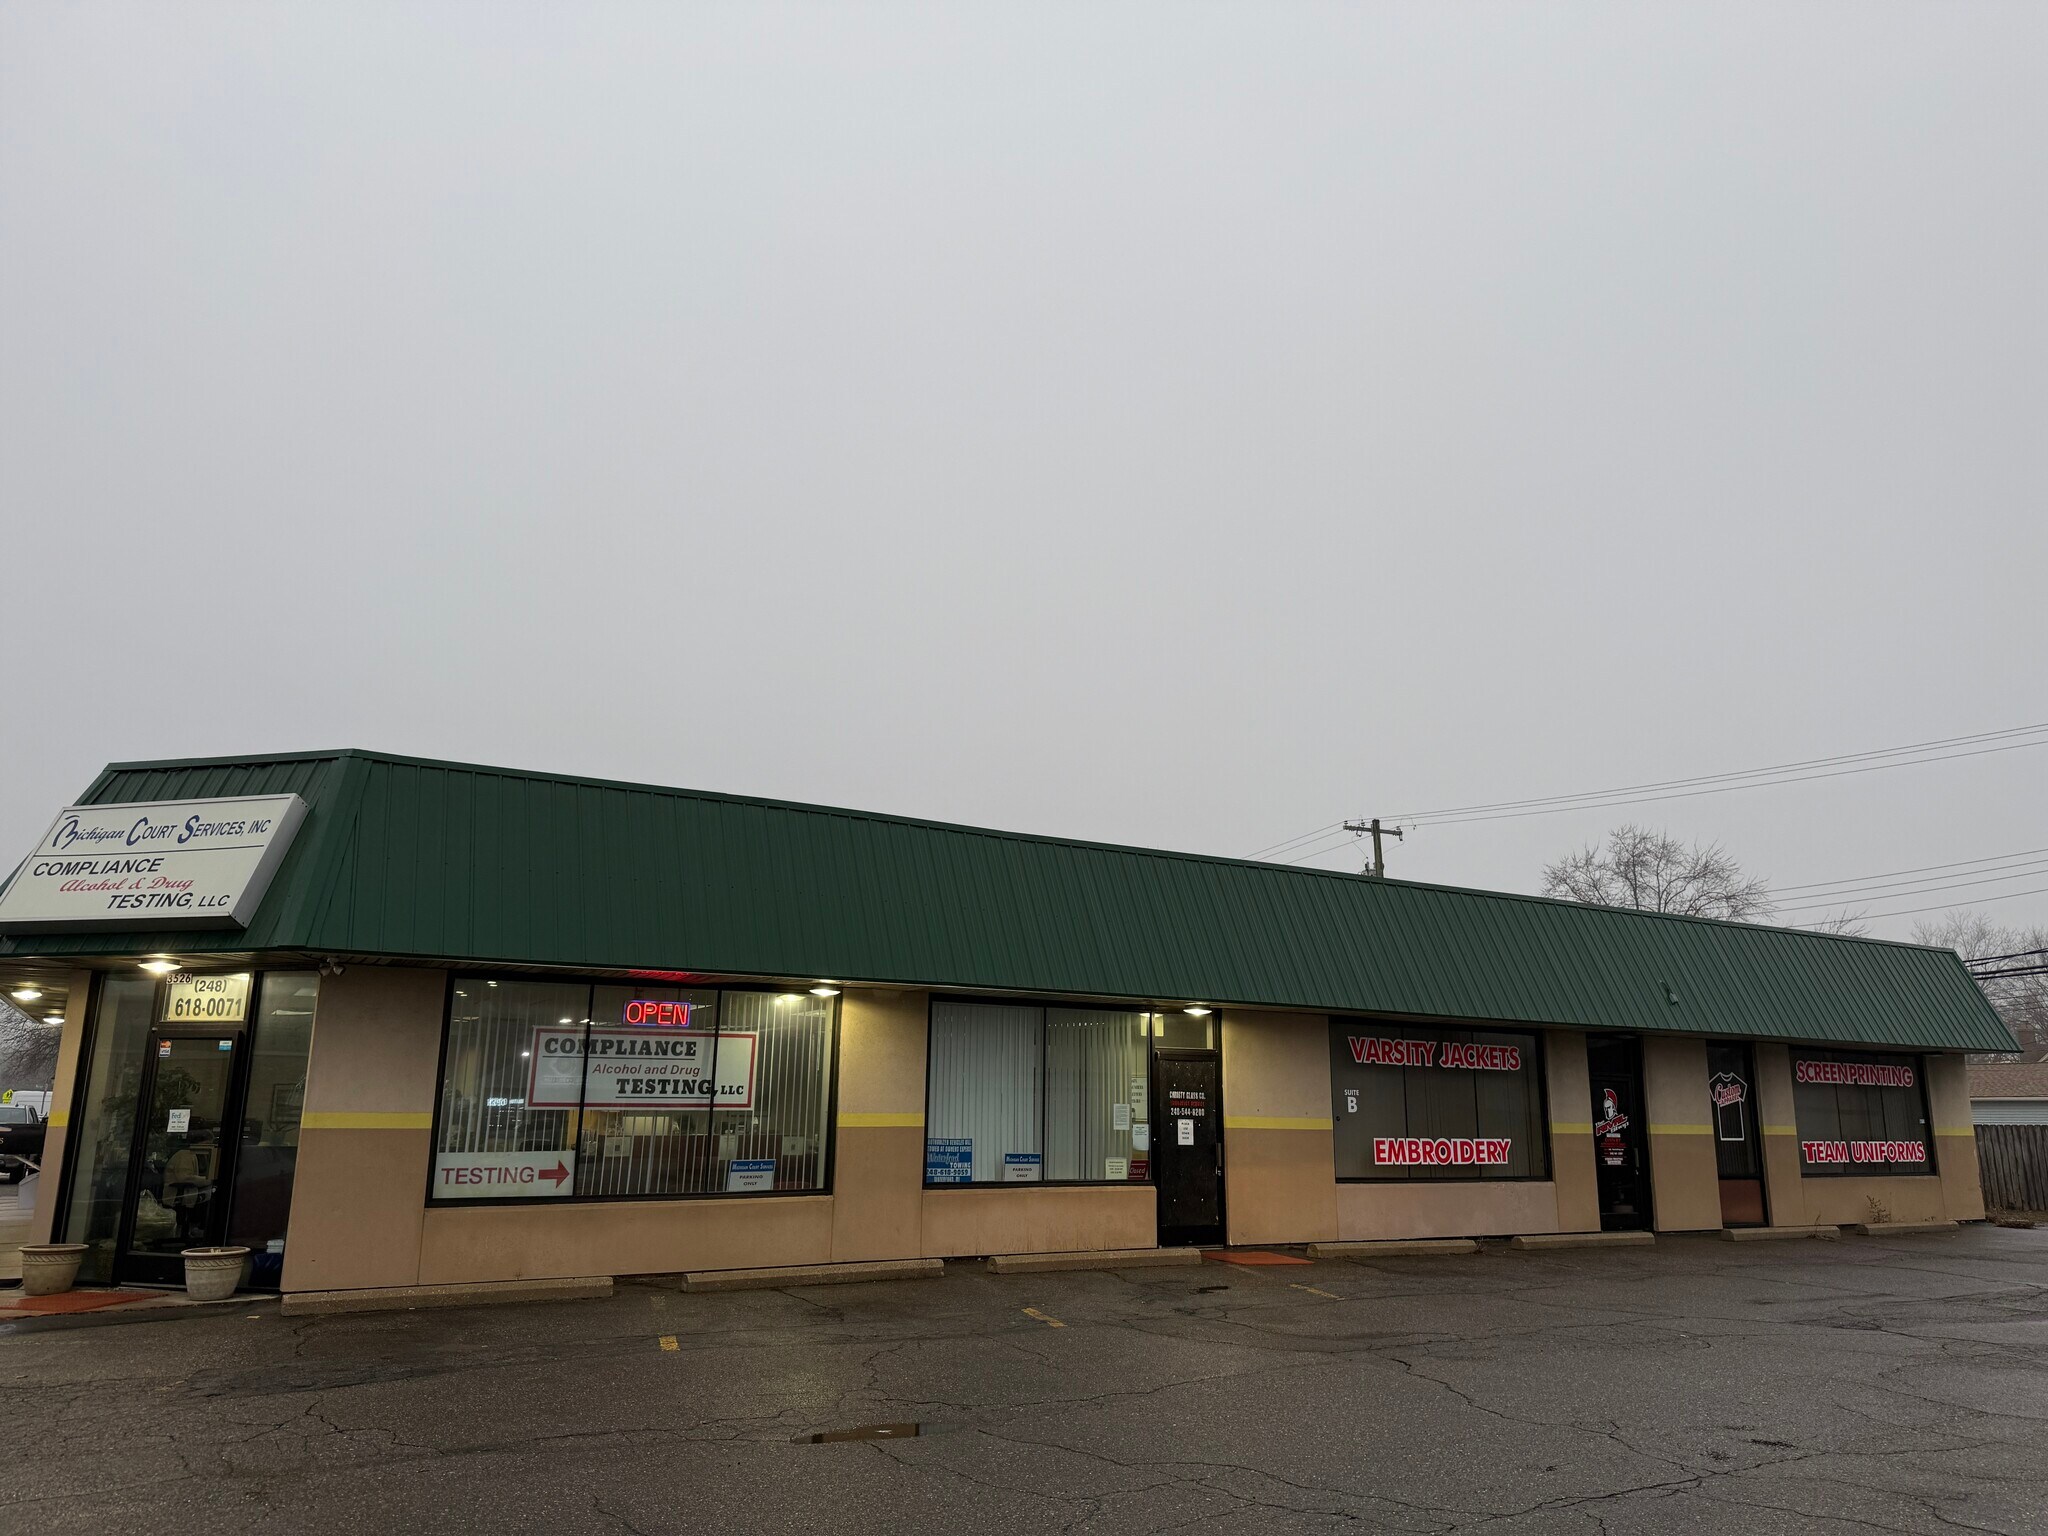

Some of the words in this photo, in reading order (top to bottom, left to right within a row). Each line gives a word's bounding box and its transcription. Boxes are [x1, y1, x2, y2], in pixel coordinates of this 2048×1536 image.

[52, 815, 125, 849] Michigan
[126, 816, 178, 846] COURT
[177, 814, 246, 844] SERVICES,
[247, 819, 271, 834] INC
[33, 858, 164, 876] COMPLIANCE
[59, 878, 128, 892] Alcohol
[147, 876, 195, 892] Drug
[107, 892, 194, 909] TESTING,
[197, 894, 230, 907] LLC
[167, 973, 192, 984] 3526
[194, 980, 227, 993] (248)
[175, 998, 242, 1017] 618-0071
[626, 1002, 689, 1025] OPEN
[544, 1037, 697, 1057] COMPLIANCE
[1348, 1036, 1438, 1067] VARSITY
[1439, 1042, 1521, 1071] JACKETS
[592, 1063, 642, 1075] Alcohol
[644, 1064, 668, 1075] and
[670, 1065, 700, 1077] Drug
[1796, 1060, 1913, 1087] SCREENPRINTING
[720, 1085, 744, 1096] LLC
[1347, 1096, 1358, 1113] B
[1373, 1137, 1511, 1165] EMBROIDERY
[1802, 1141, 1849, 1163] TEAM
[1851, 1141, 1925, 1163] UNIFORMS
[441, 1166, 535, 1185] TESTING
